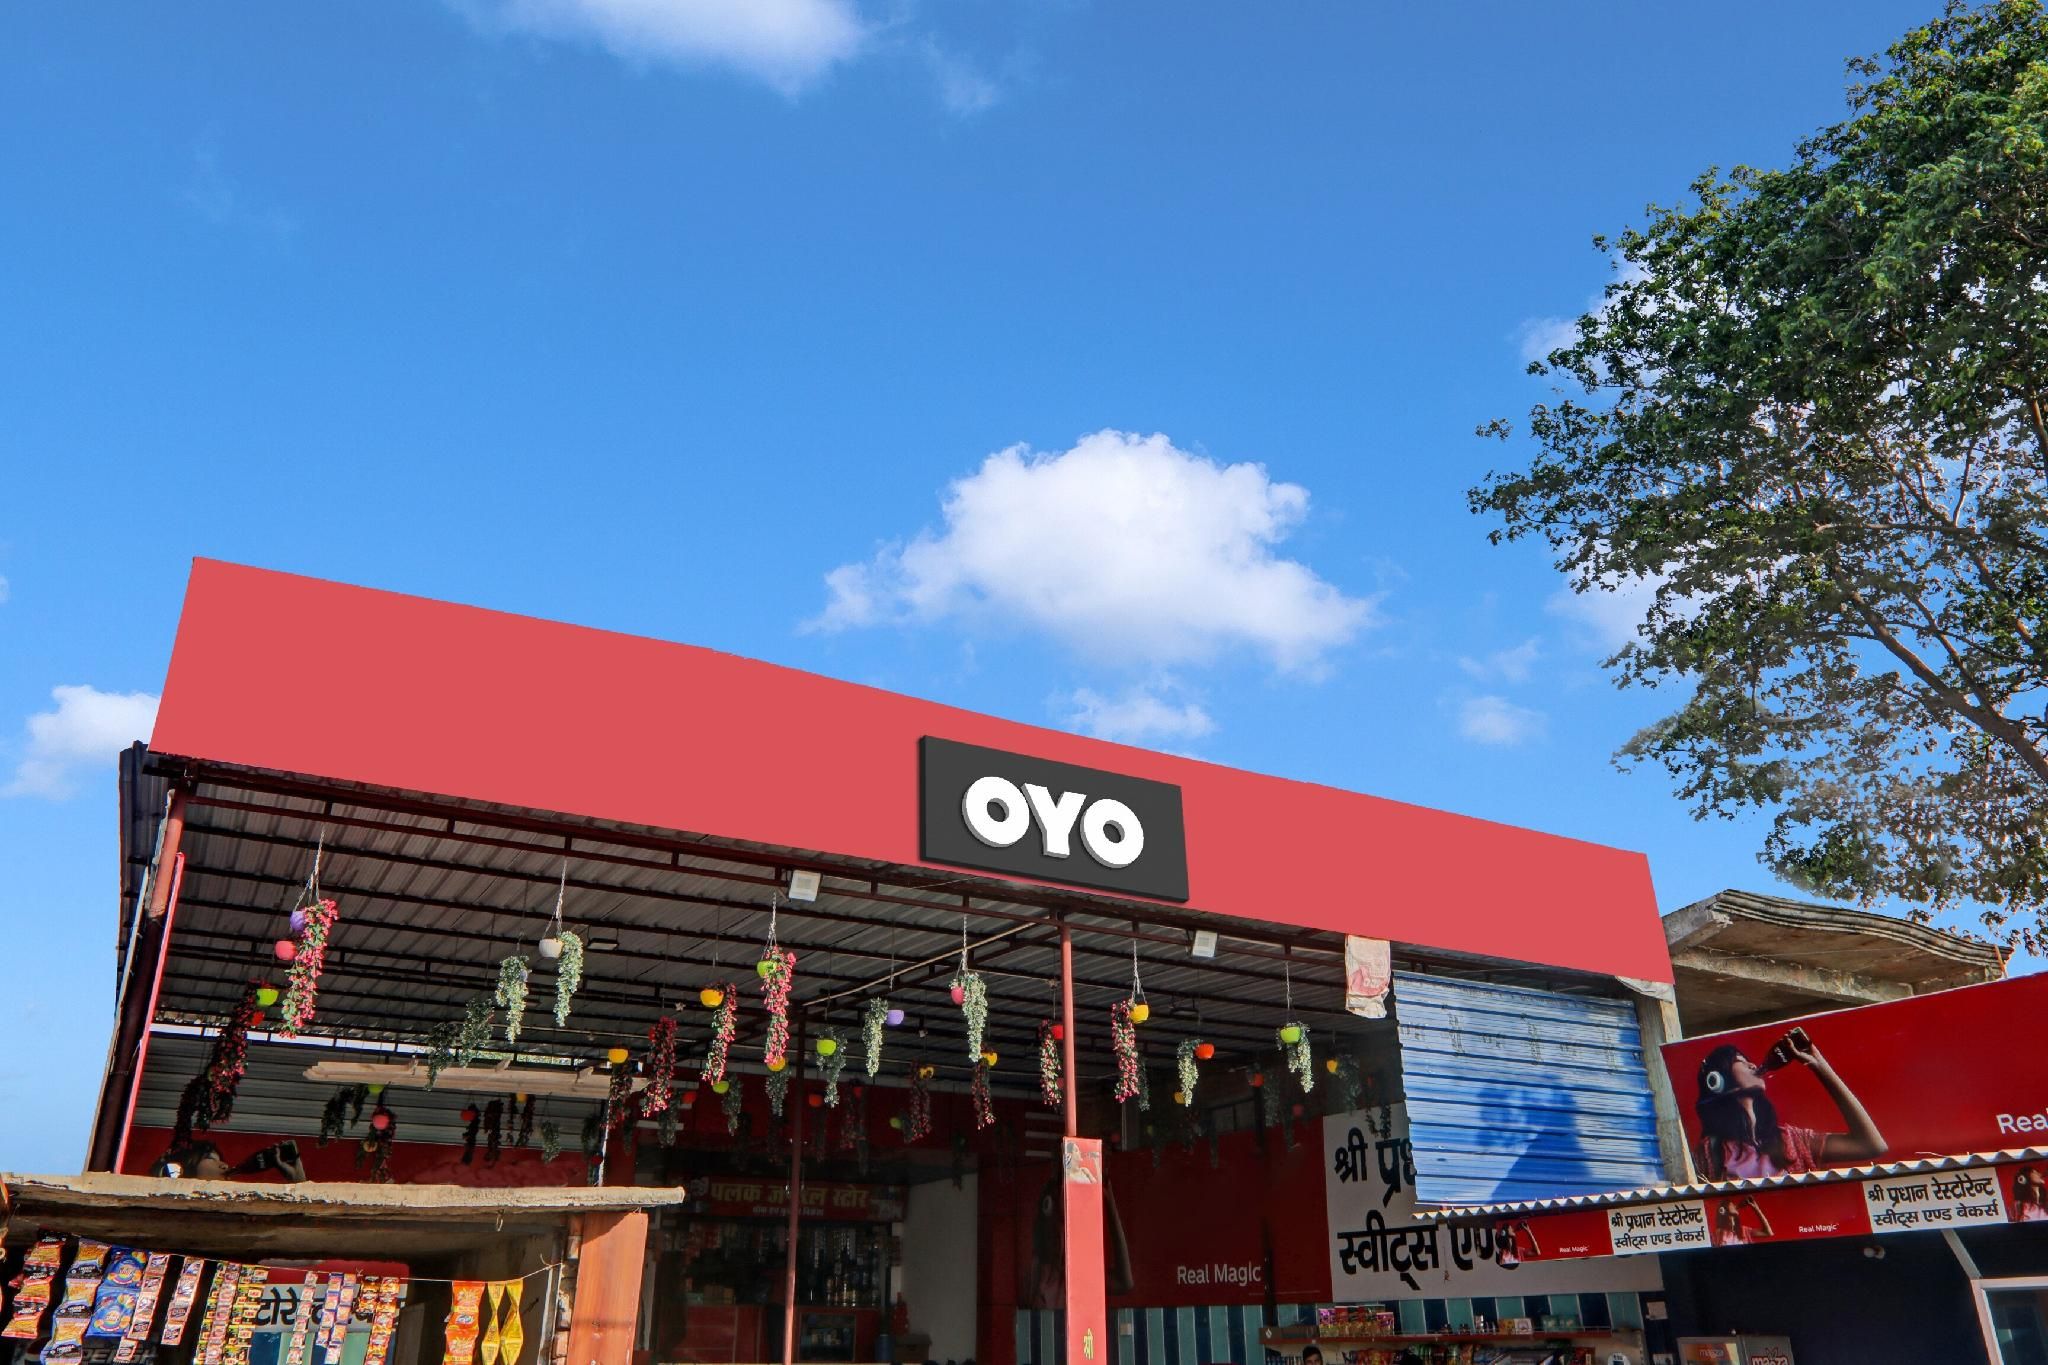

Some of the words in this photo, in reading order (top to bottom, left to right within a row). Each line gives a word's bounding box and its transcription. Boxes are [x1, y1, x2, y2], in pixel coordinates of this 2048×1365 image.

[962, 776, 1144, 868] OYO
[1334, 1127, 1368, 1184] श्री
[711, 1183, 763, 1201] पलक
[768, 1184, 828, 1205] जरल
[1867, 1183, 1884, 1202] श्री
[1887, 1182, 1929, 1208] प्रधान
[1931, 1172, 1995, 1200] रेस्टोरेन्ट
[1611, 1213, 1623, 1227] श्री
[1625, 1212, 1656, 1233] प्रधान
[1657, 1204, 1703, 1227] रेस्टोरेन्ट
[1873, 1207, 1919, 1228] स्वीट्स
[1922, 1206, 1953, 1223] एण्ड
[1956, 1198, 2000, 1218] बेकर्स
[1614, 1230, 1647, 1250] स्वीट्स
[1651, 1233, 1671, 1245] एण्ड
[1674, 1226, 1705, 1242] बेकर्स
[1798, 1225, 1815, 1233] Real
[1816, 1224, 1837, 1232] Magic
[1337, 1210, 1440, 1291] स्वीट्स
[1177, 1264, 1209, 1285] Real
[1214, 1262, 1262, 1287] Magic
